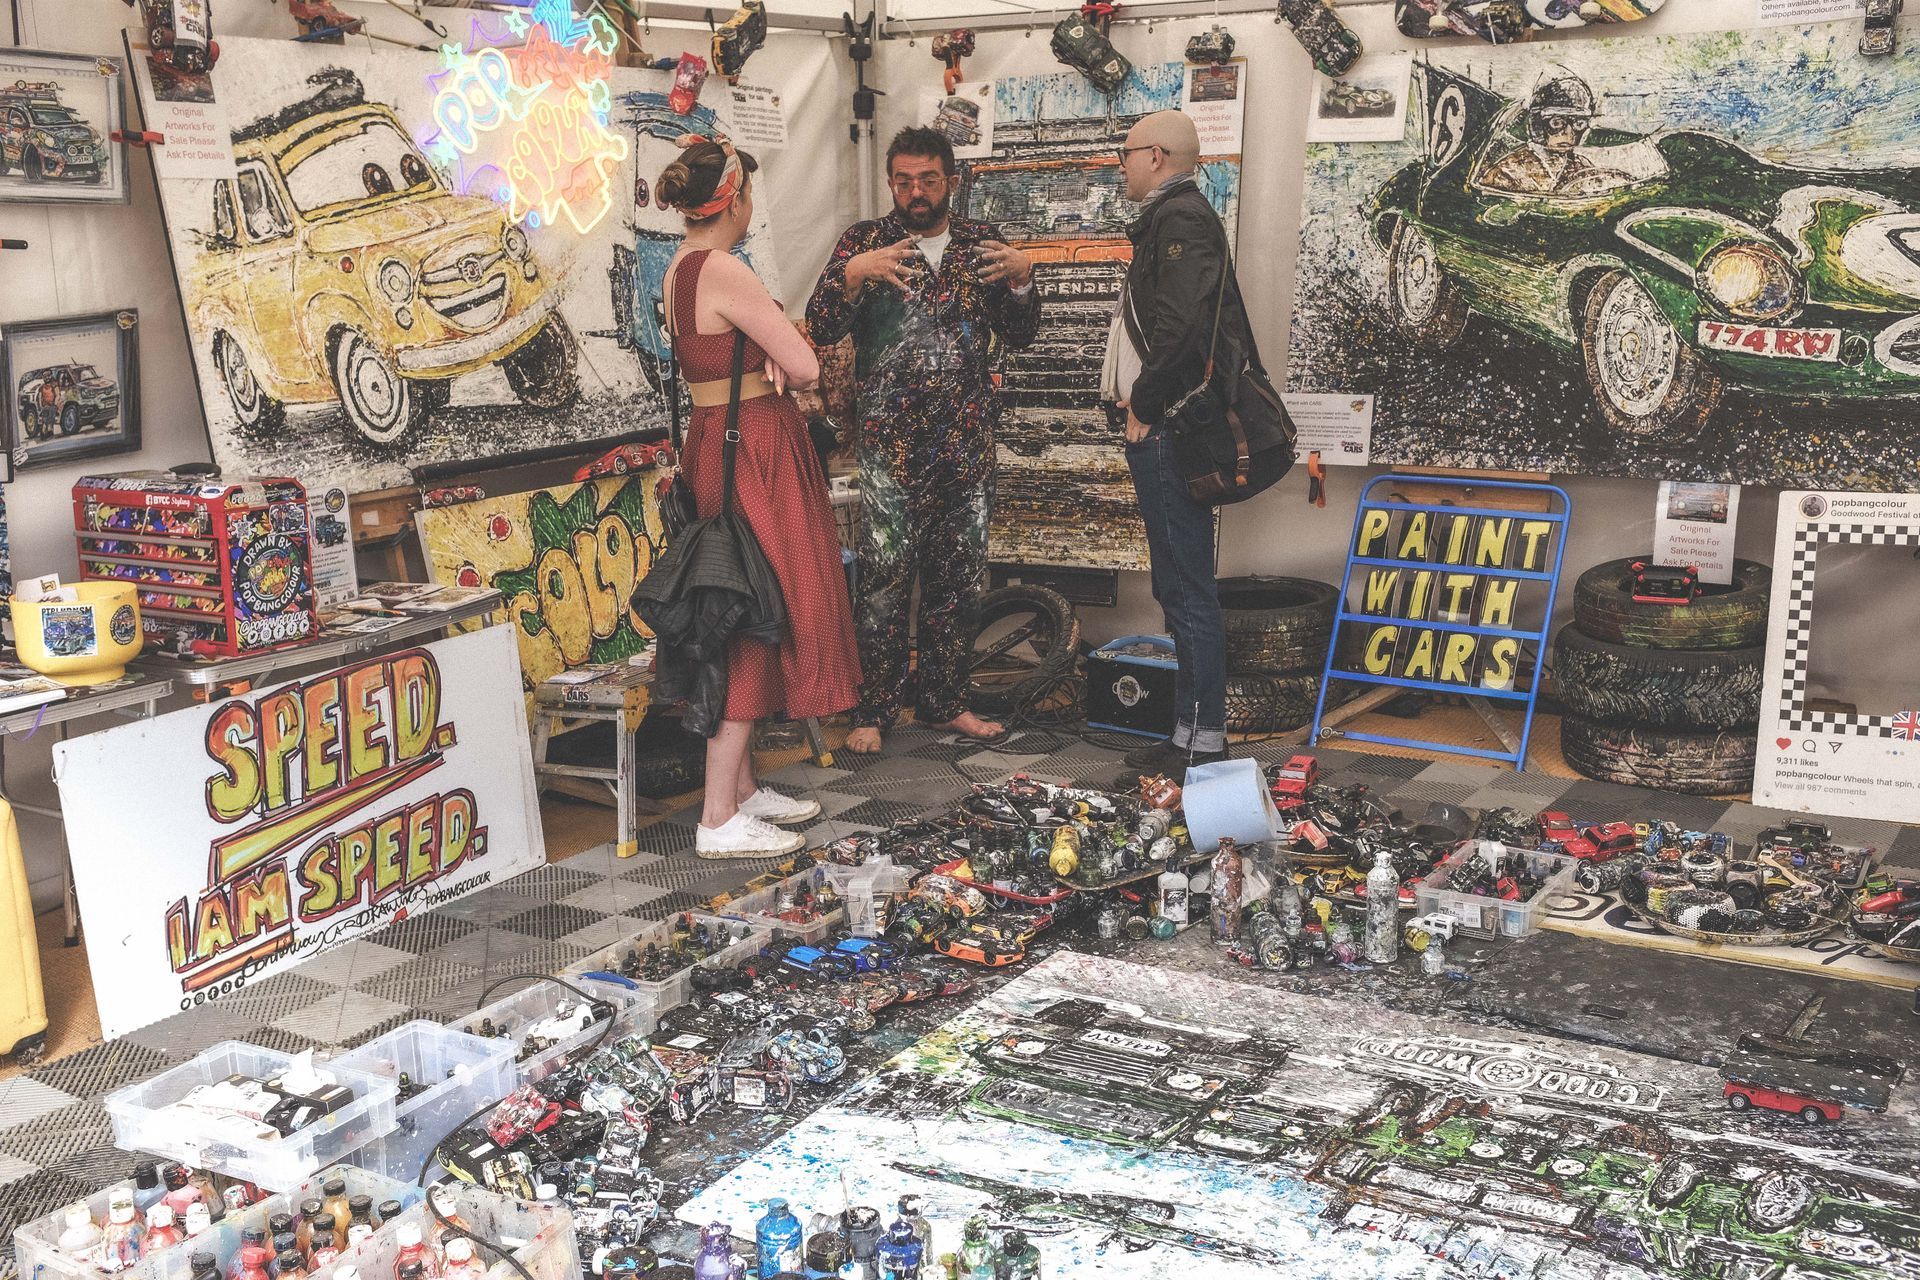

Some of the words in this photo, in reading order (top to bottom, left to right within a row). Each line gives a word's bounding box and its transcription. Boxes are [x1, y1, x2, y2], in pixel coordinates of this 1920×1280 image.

[1761, 2, 1785, 11] Others
[433, 48, 513, 154] POP
[172, 107, 204, 118] Original
[1200, 104, 1225, 112] Original
[165, 122, 201, 131] Artworks
[202, 122, 215, 131] For
[170, 136, 187, 145] Sale
[189, 136, 216, 146] Please
[166, 151, 182, 160] Ask
[183, 151, 197, 160] For
[198, 151, 225, 160] Details
[153, 495, 170, 505] BTCC
[1831, 499, 1908, 509] popbangcolour
[1831, 509, 1875, 518] Goodwood
[1877, 510, 1910, 519] Festival
[1679, 524, 1711, 534] Original
[1357, 510, 1551, 569] PAINT
[1669, 535, 1706, 545] Artworks
[1707, 537, 1720, 546] For
[243, 535, 276, 567] DRAWN
[278, 536, 293, 550] BY
[1670, 546, 1688, 555] Sale
[1690, 548, 1717, 558] Please
[1662, 558, 1677, 566] Ask
[1694, 560, 1723, 570] Details
[239, 564, 301, 612] POPBANGCOLOUR
[1367, 570, 1519, 625] WITH
[1364, 626, 1518, 689] CARS
[205, 648, 457, 823] SPEED.
[1776, 756, 1798, 765] 9,311
[1799, 757, 1819, 767] likes
[1775, 769, 1842, 782] popbangcolour
[1843, 775, 1874, 785] Wheels
[1876, 777, 1892, 787] that
[1895, 779, 1915, 789] spin,
[1774, 781, 1793, 790] View
[1795, 782, 1805, 791] all
[1806, 784, 1822, 792] 987
[1824, 786, 1867, 796] comments
[297, 788, 488, 923] SPEED.
